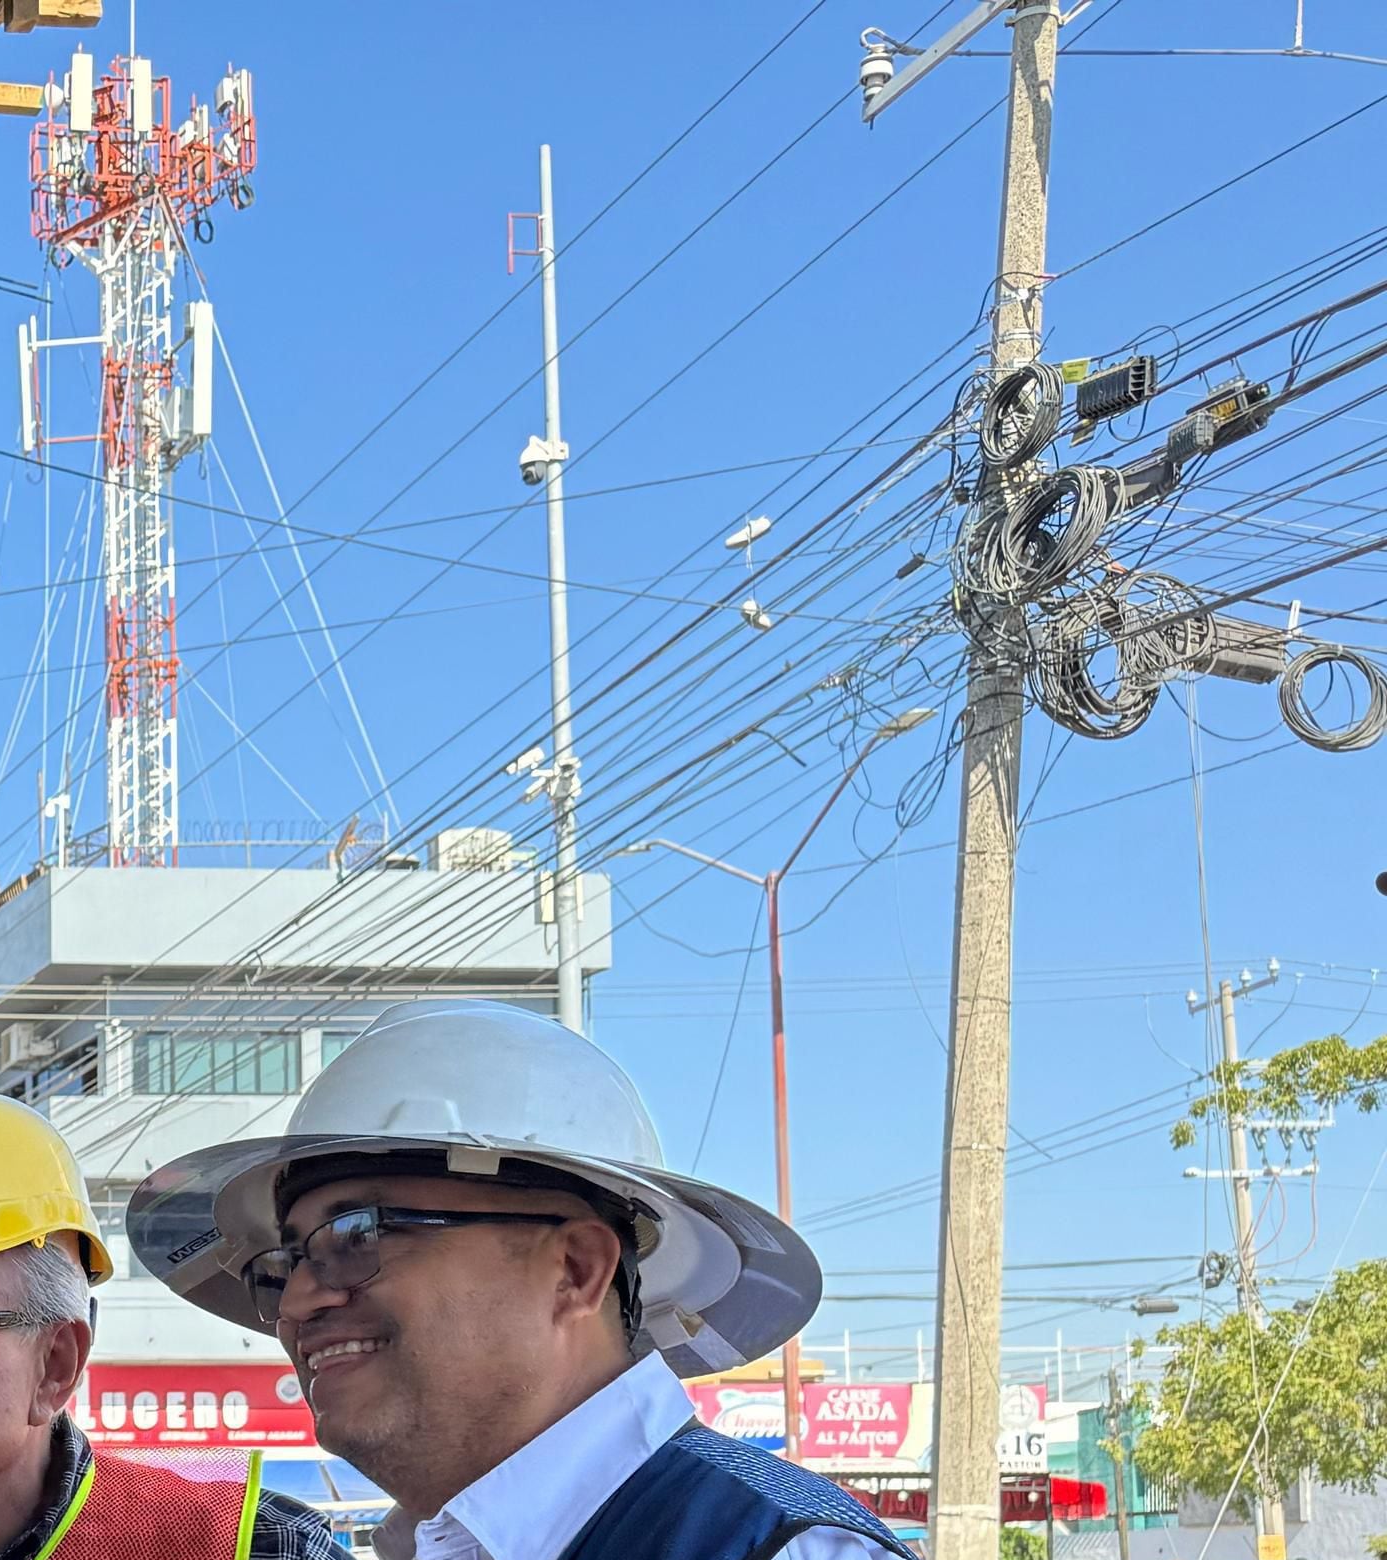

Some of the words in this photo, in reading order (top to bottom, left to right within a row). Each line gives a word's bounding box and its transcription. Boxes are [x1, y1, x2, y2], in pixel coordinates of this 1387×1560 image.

[815, 1400, 898, 1421] ASADA
[815, 1430, 837, 1445] AL
[838, 1430, 898, 1446] PASTOR
